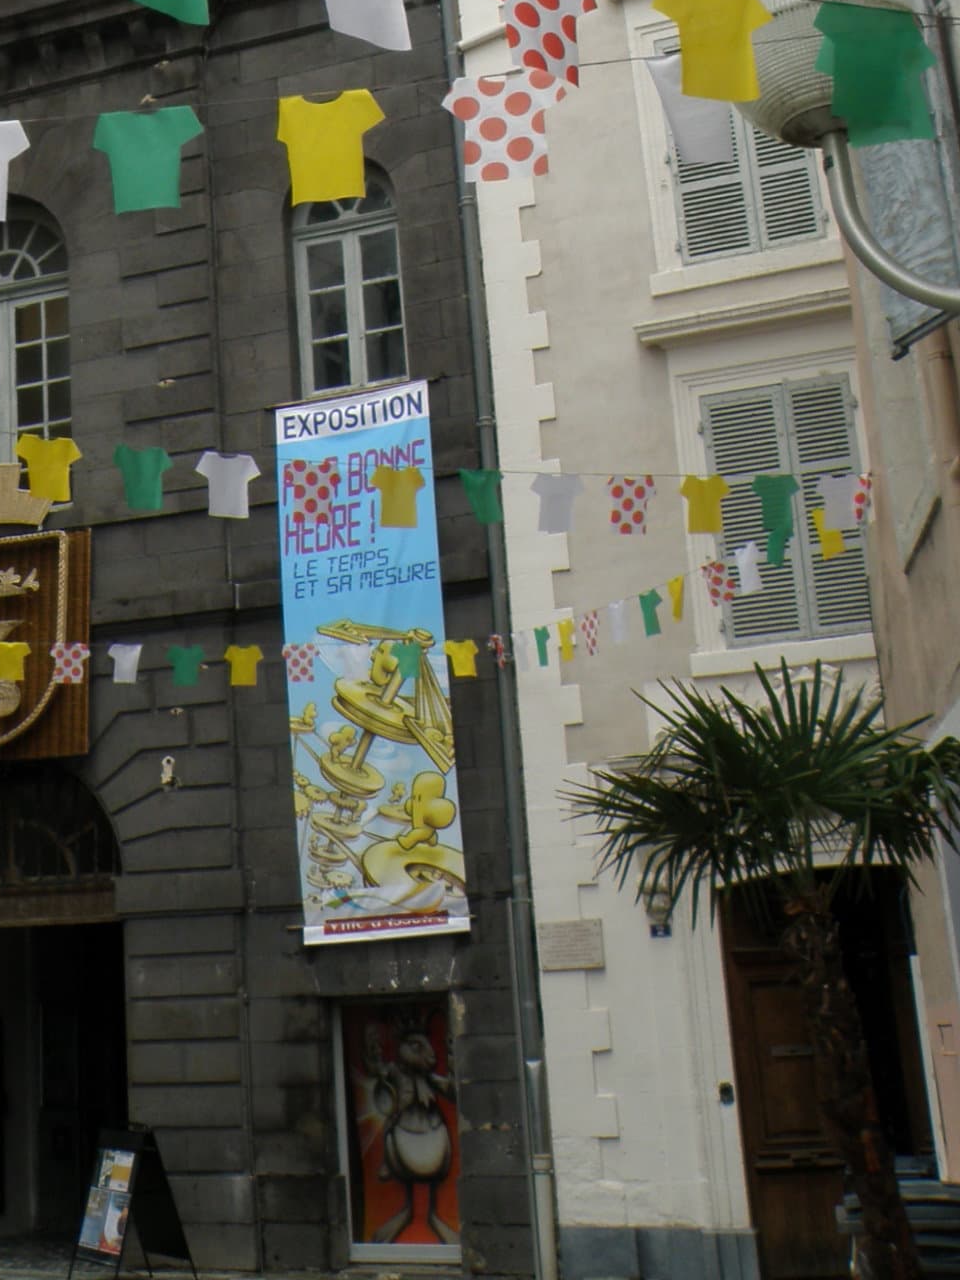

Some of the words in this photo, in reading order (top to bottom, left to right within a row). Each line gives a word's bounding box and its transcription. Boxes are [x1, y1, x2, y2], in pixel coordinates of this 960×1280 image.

[283, 391, 423, 439] EXPOSITION
[293, 560, 318, 579] LE
[327, 548, 390, 573] TEMPS
[294, 580, 319, 600] ET
[327, 575, 352, 594] SA
[359, 560, 436, 589] MESURE
